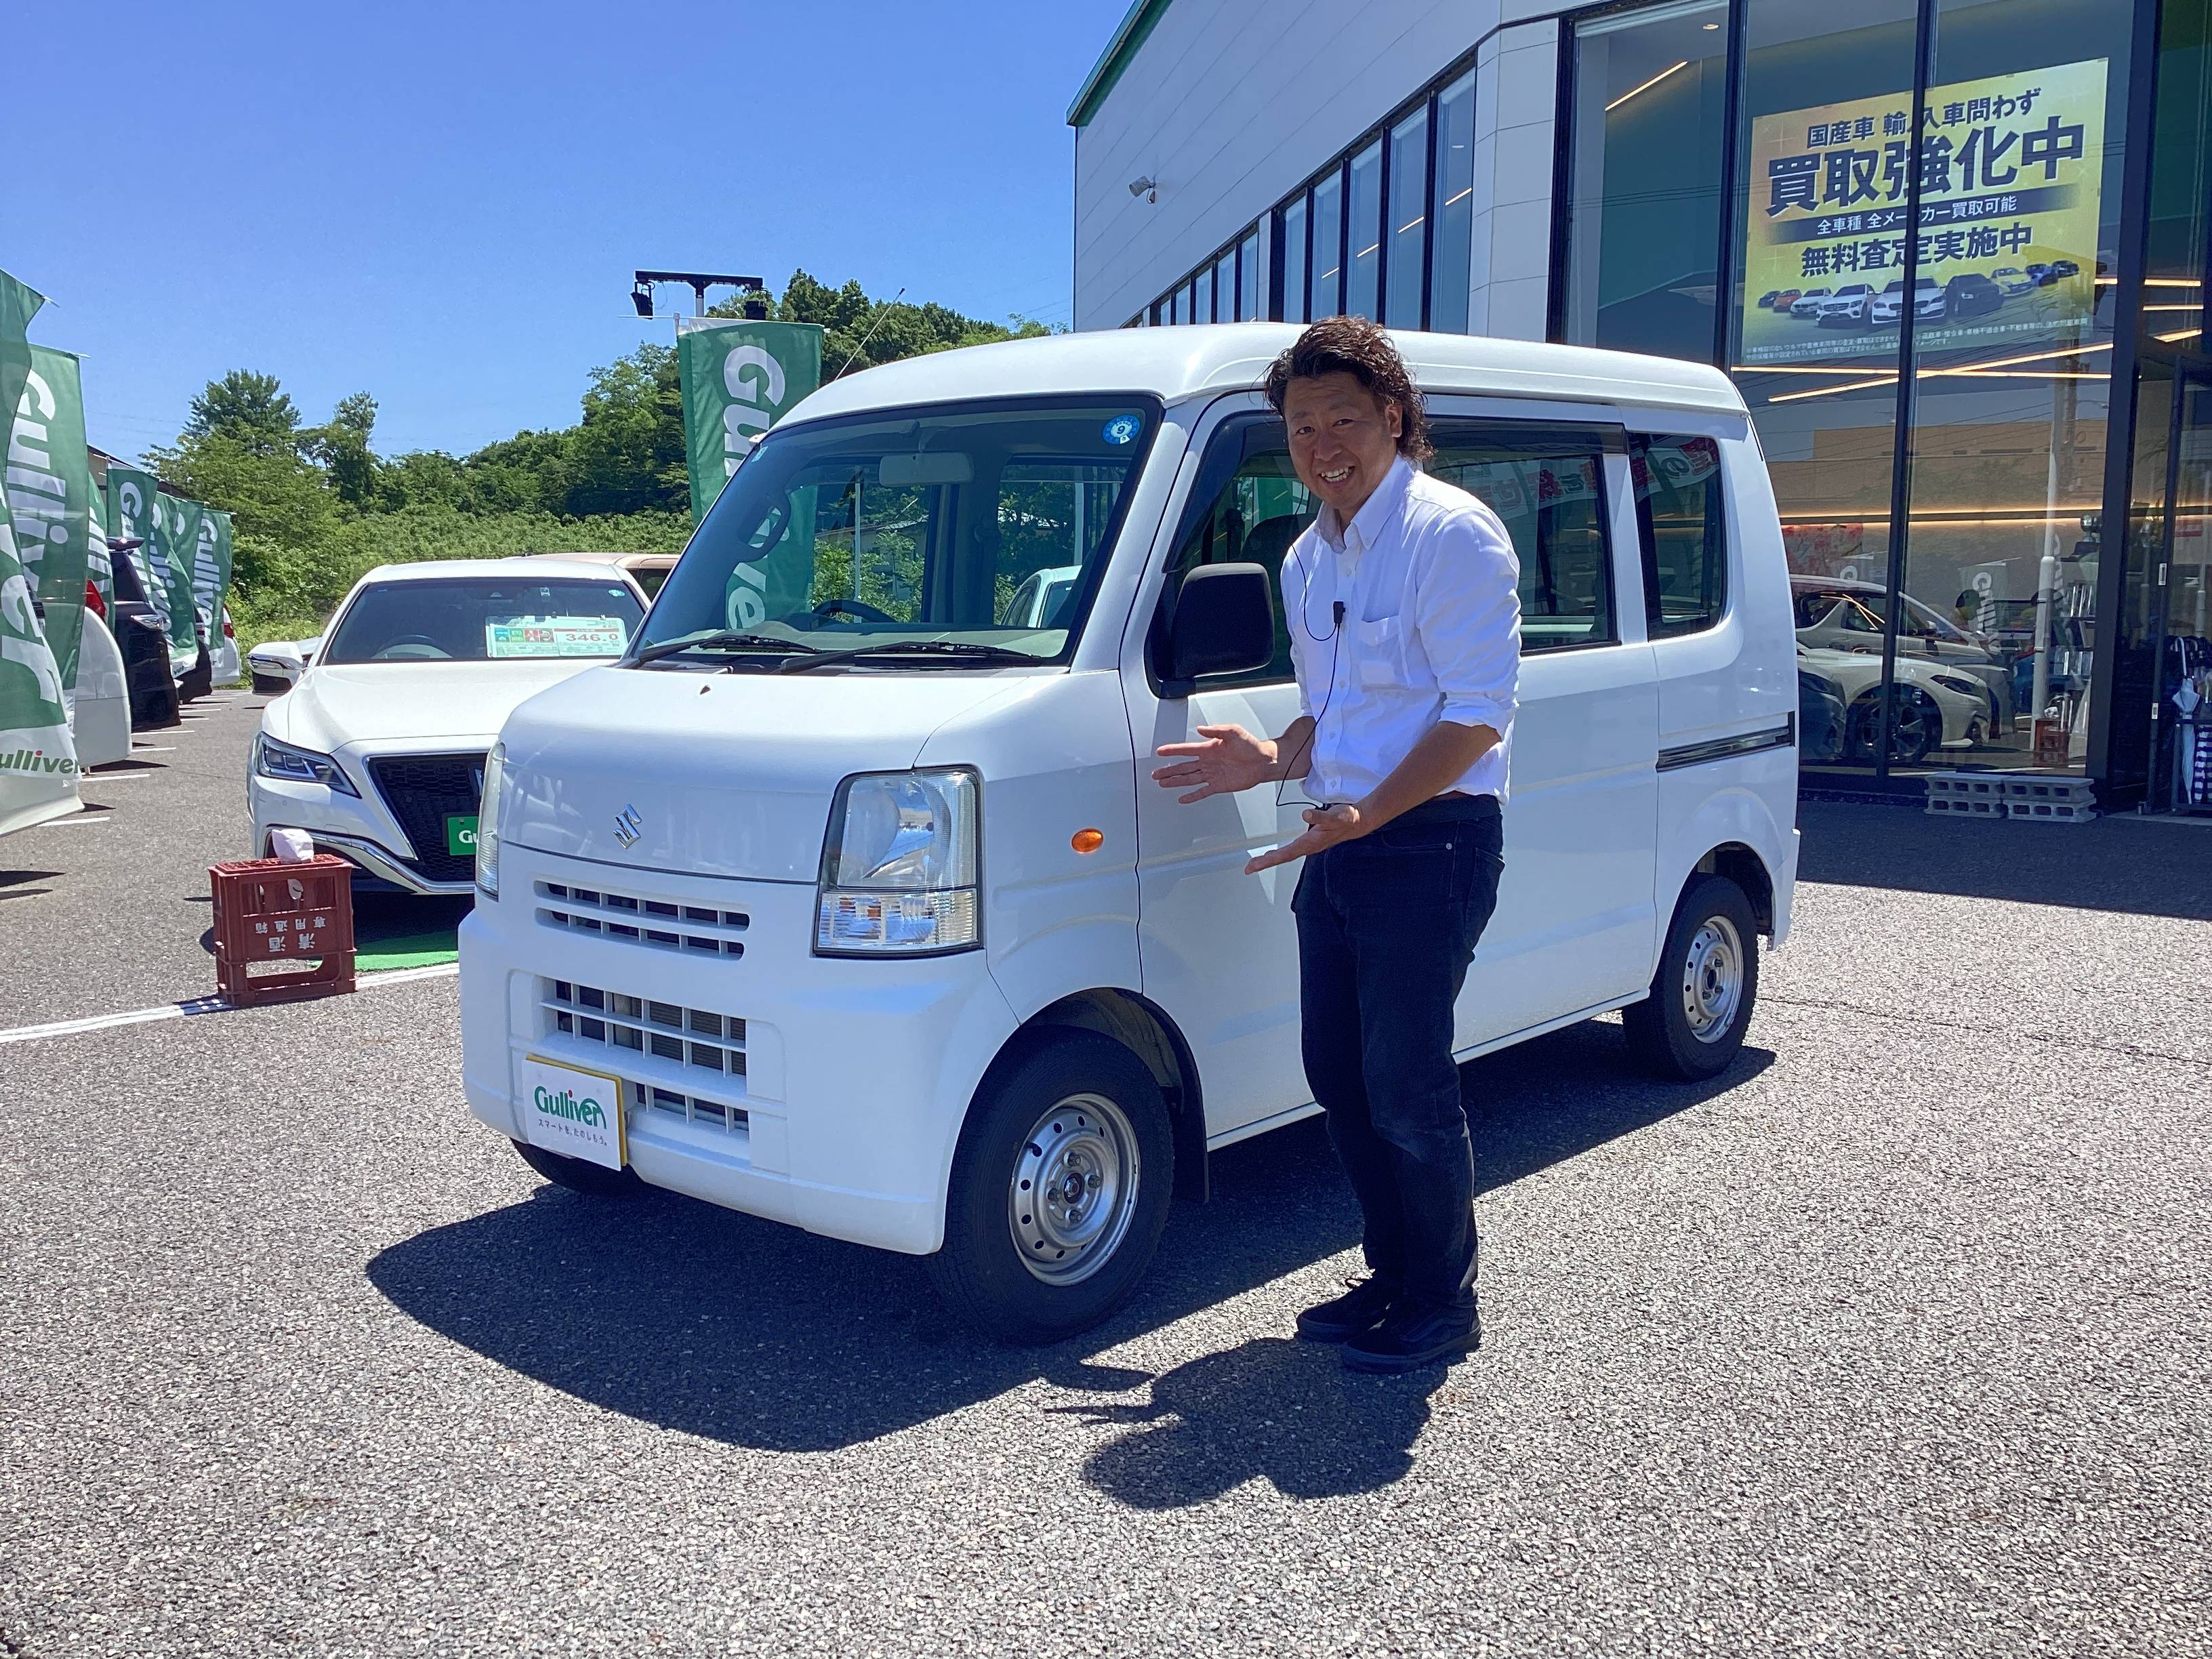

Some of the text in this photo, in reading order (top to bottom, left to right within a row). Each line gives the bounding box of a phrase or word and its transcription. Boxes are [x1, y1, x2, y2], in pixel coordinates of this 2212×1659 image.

[1807, 117, 1875, 148] 国産車
[1765, 115, 2085, 218] 買取強化中
[1817, 216, 1862, 236] 全車種
[1801, 222, 2032, 277] 無料査定実施中
[565, 633, 619, 642] 346.0
[0, 750, 80, 773] ulliver
[534, 1086, 607, 1130] Gulliver
